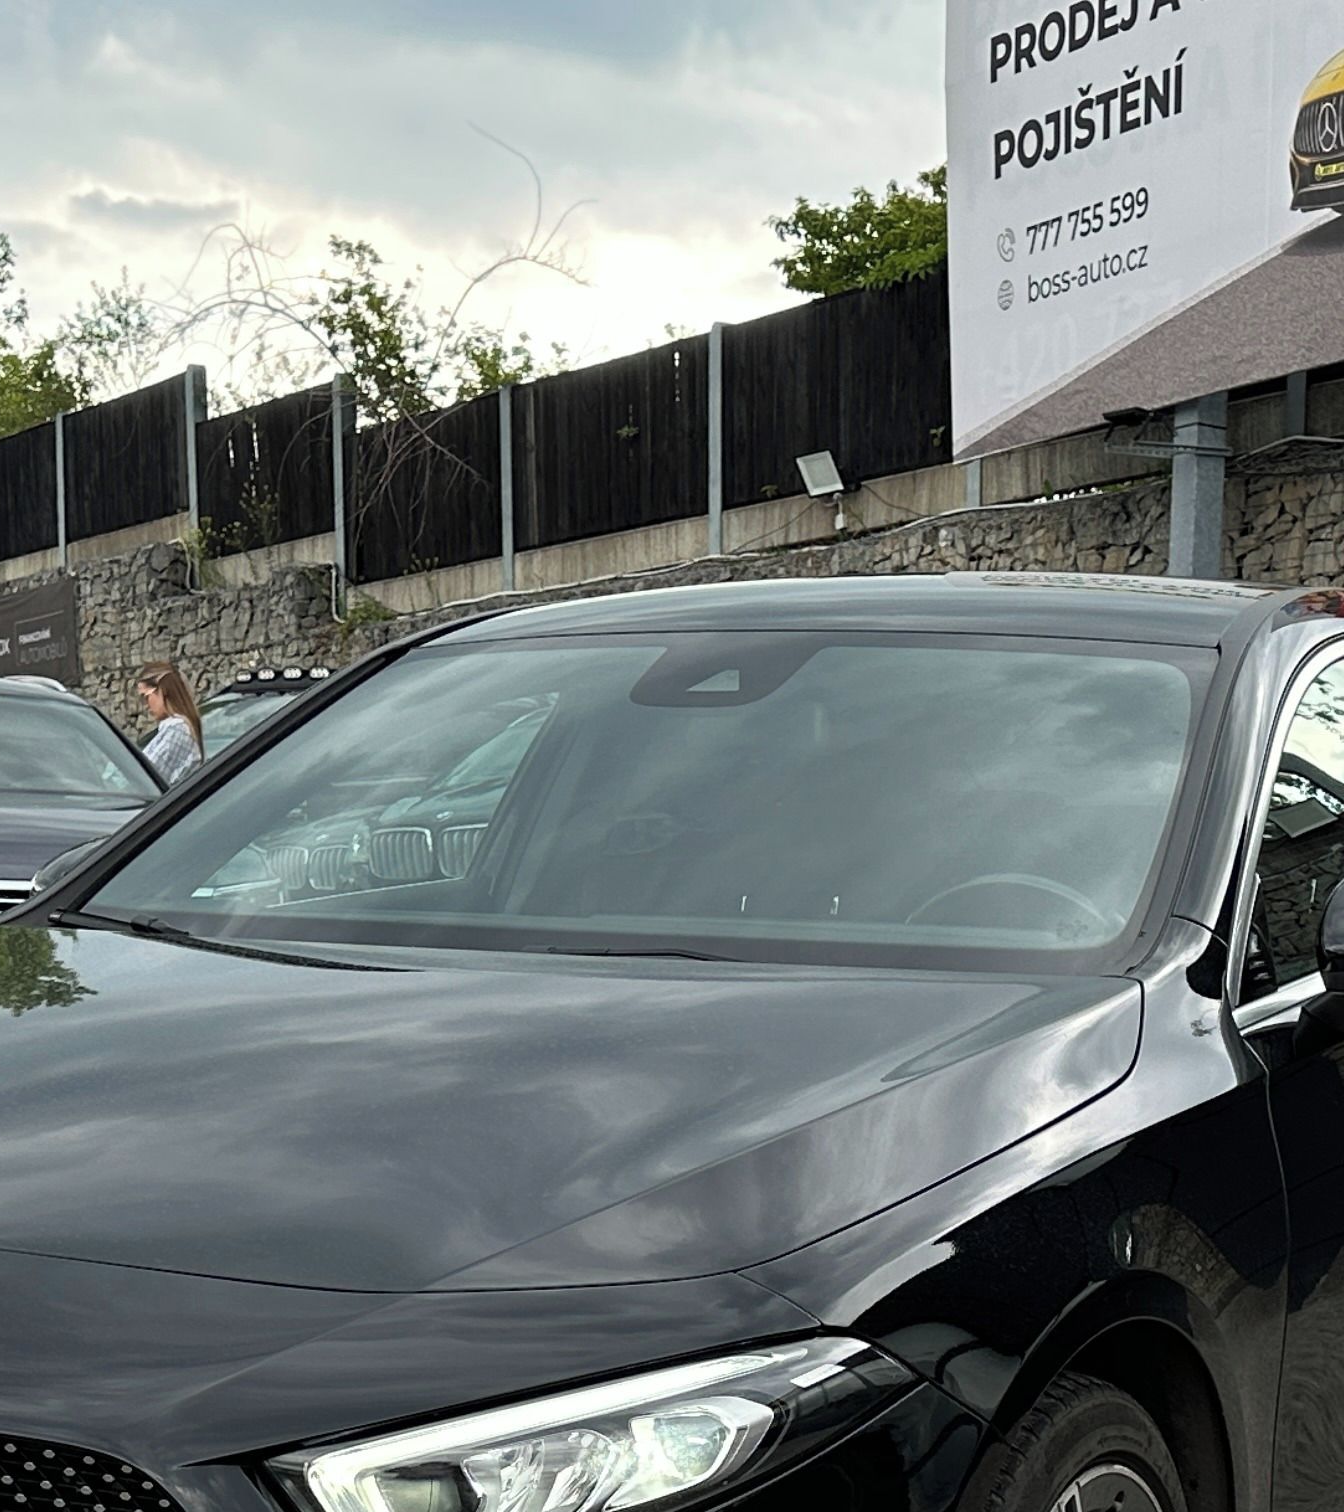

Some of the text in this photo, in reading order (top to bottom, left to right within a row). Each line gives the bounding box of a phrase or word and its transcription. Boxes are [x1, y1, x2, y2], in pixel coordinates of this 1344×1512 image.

[990, 0, 1139, 83] PRODEJ
[994, 47, 1188, 180] POJIŠTĚNÍ
[1026, 186, 1149, 255] 777 755 599
[1027, 245, 1149, 304] boss-auto.cz
